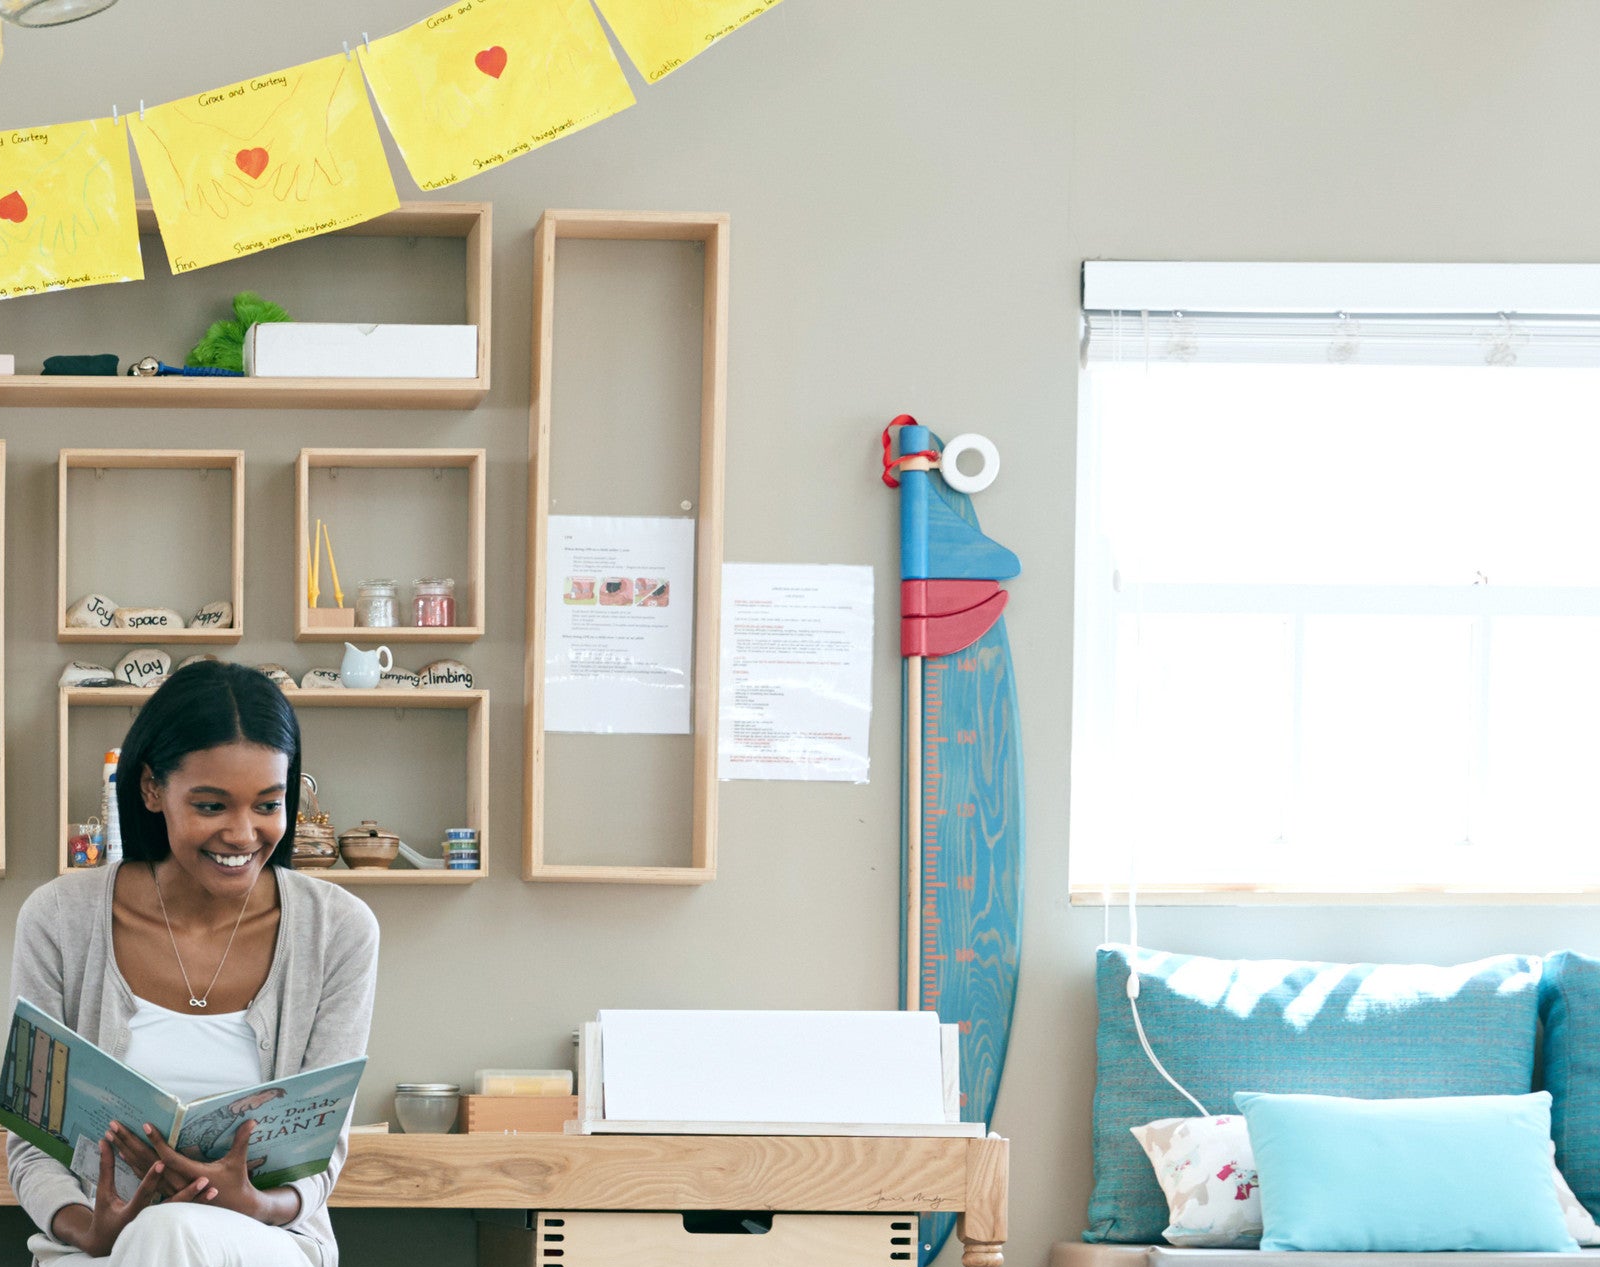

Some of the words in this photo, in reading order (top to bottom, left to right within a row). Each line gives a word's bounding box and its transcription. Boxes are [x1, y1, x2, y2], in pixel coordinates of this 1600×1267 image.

[426, 14, 453, 29] Grace
[458, 2, 472, 14] and
[649, 58, 683, 81] Caitlin
[198, 94, 224, 106] Grace
[229, 86, 244, 98] and
[250, 76, 287, 91] Courtesy
[12, 134, 48, 144] Courtesy
[174, 256, 197, 272] Finn
[87, 598, 114, 627] Joy
[128, 616, 168, 628] space
[958, 658, 976, 672] 140
[380, 672, 420, 687] umping
[957, 730, 976, 744] 130
[956, 803, 976, 817] 120
[956, 948, 975, 962] 100
[255, 1115, 278, 1124] My
[285, 1098, 340, 1116] Daddy
[248, 1110, 336, 1146] GIANT
